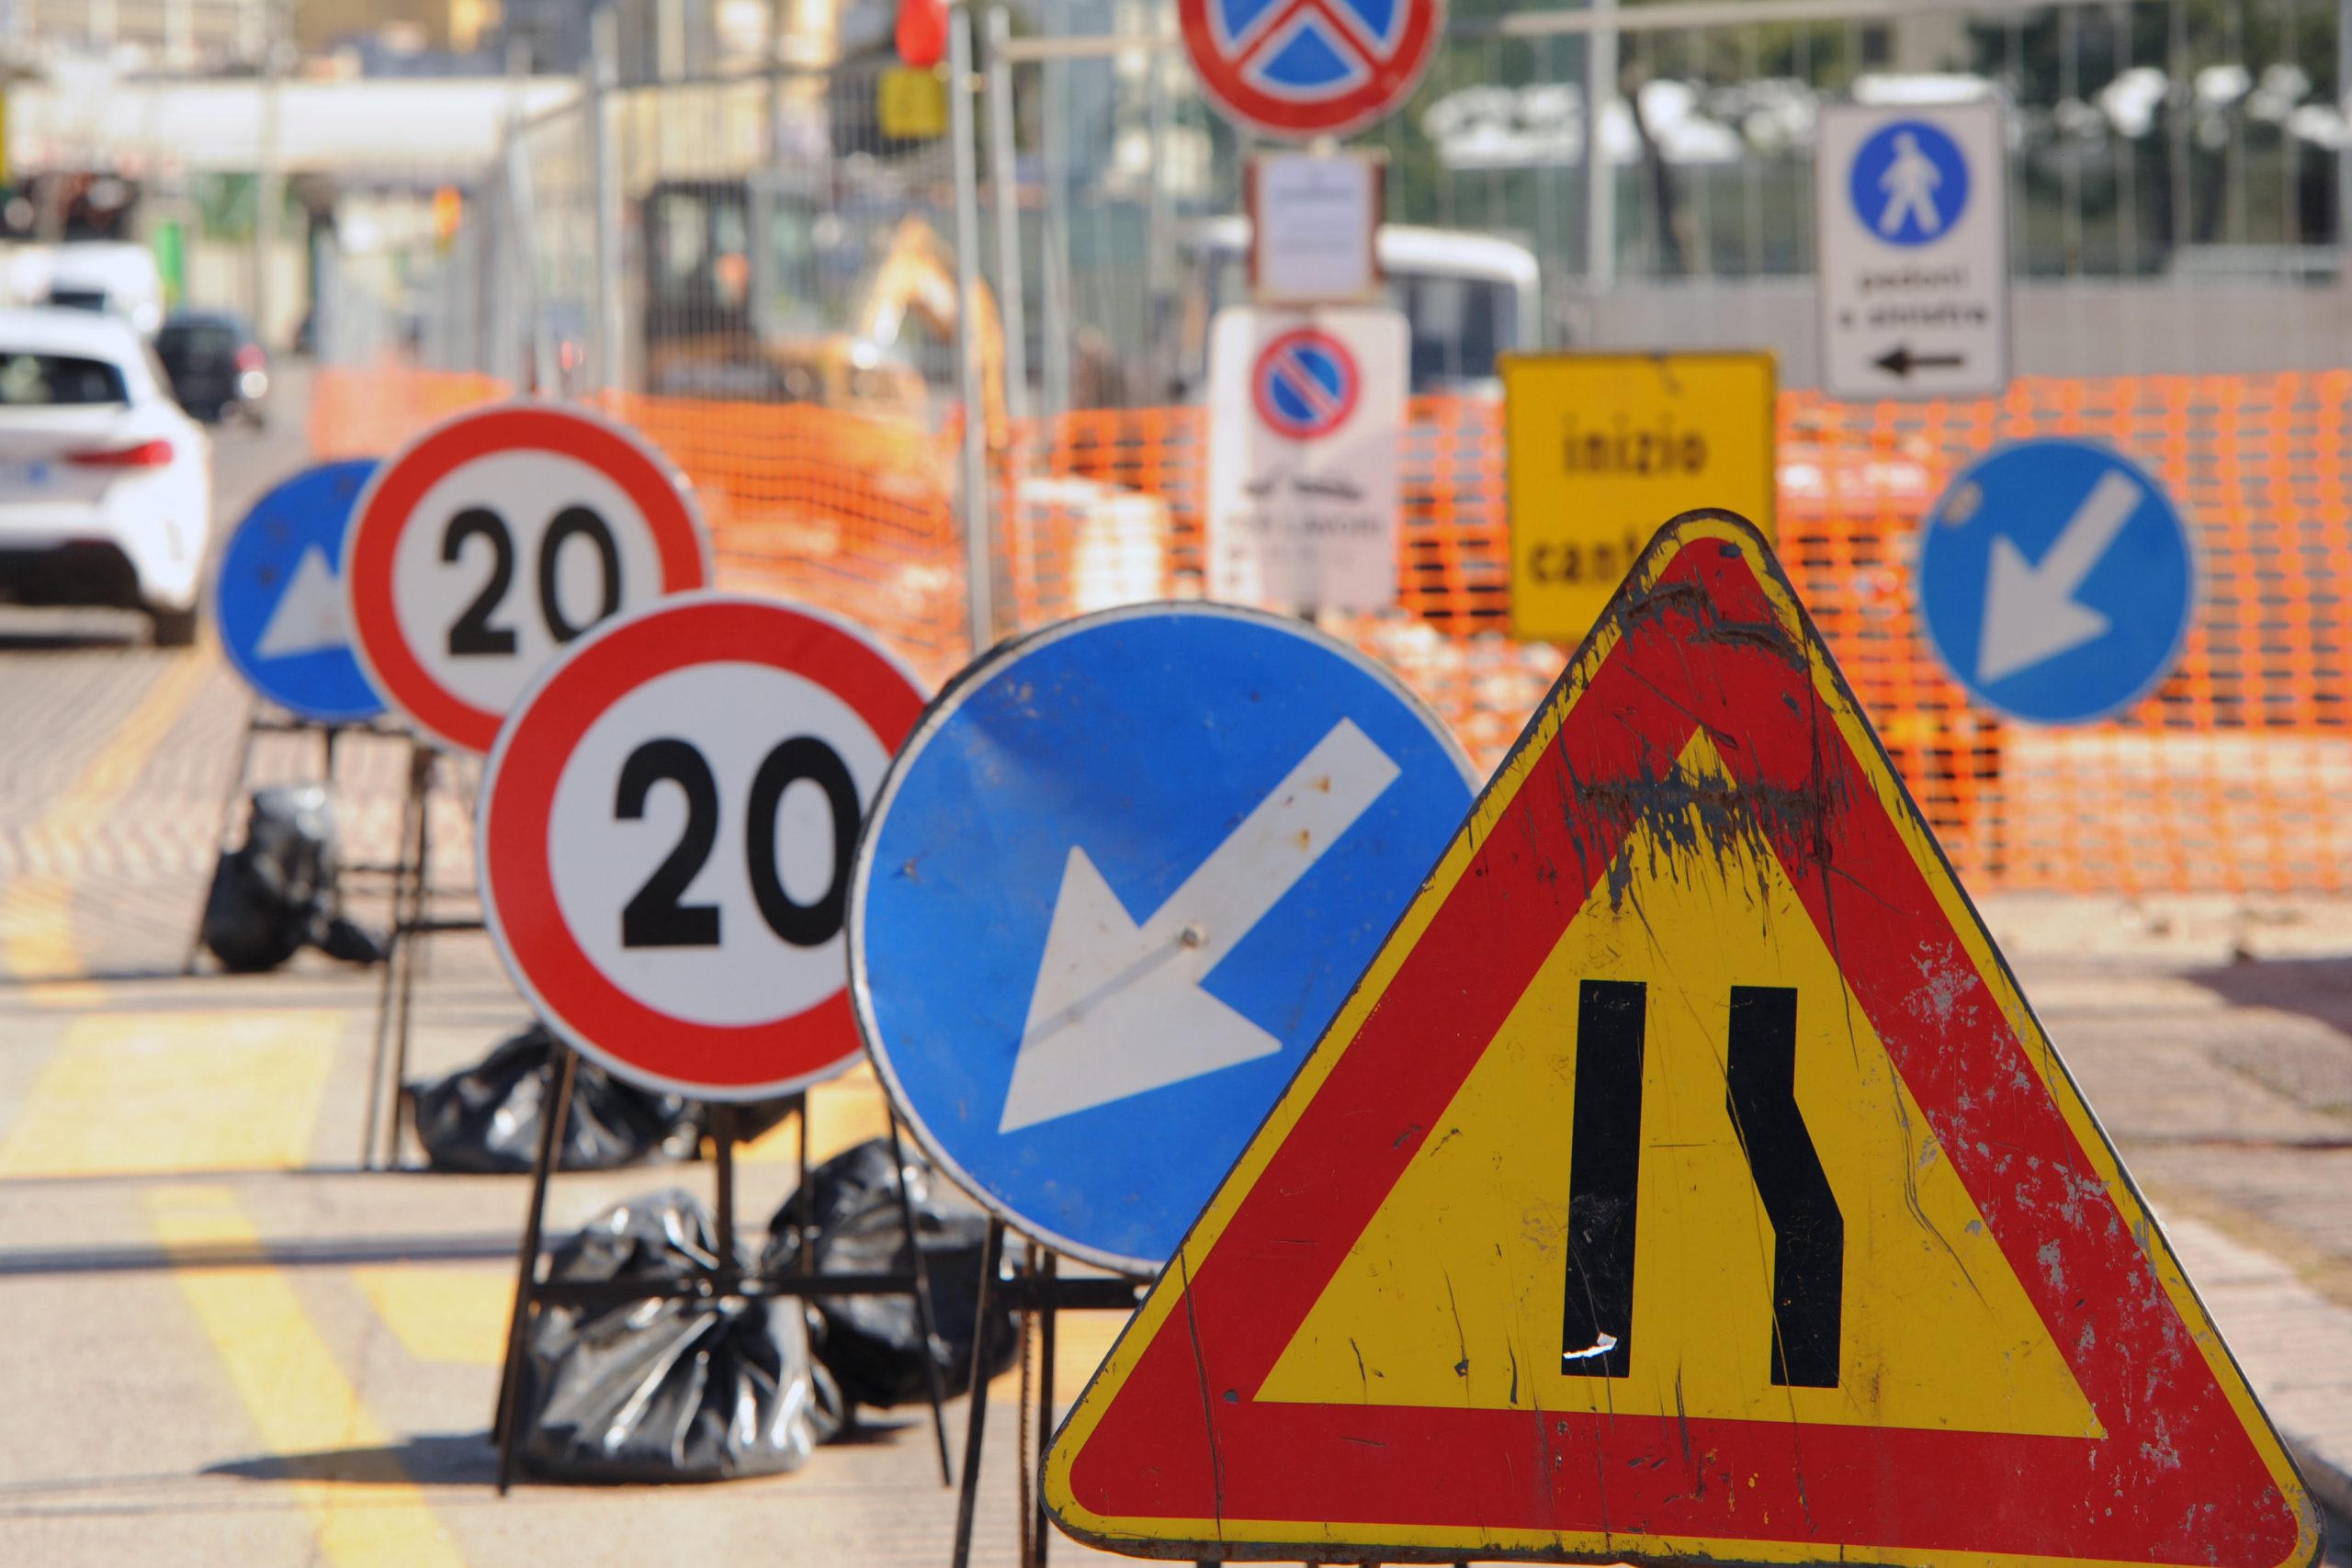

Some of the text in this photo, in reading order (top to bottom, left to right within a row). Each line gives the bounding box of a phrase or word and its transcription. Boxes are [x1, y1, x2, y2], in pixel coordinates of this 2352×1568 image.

[1563, 413, 1708, 477] inizio
[440, 505, 619, 655] 20
[614, 736, 862, 948] 20
